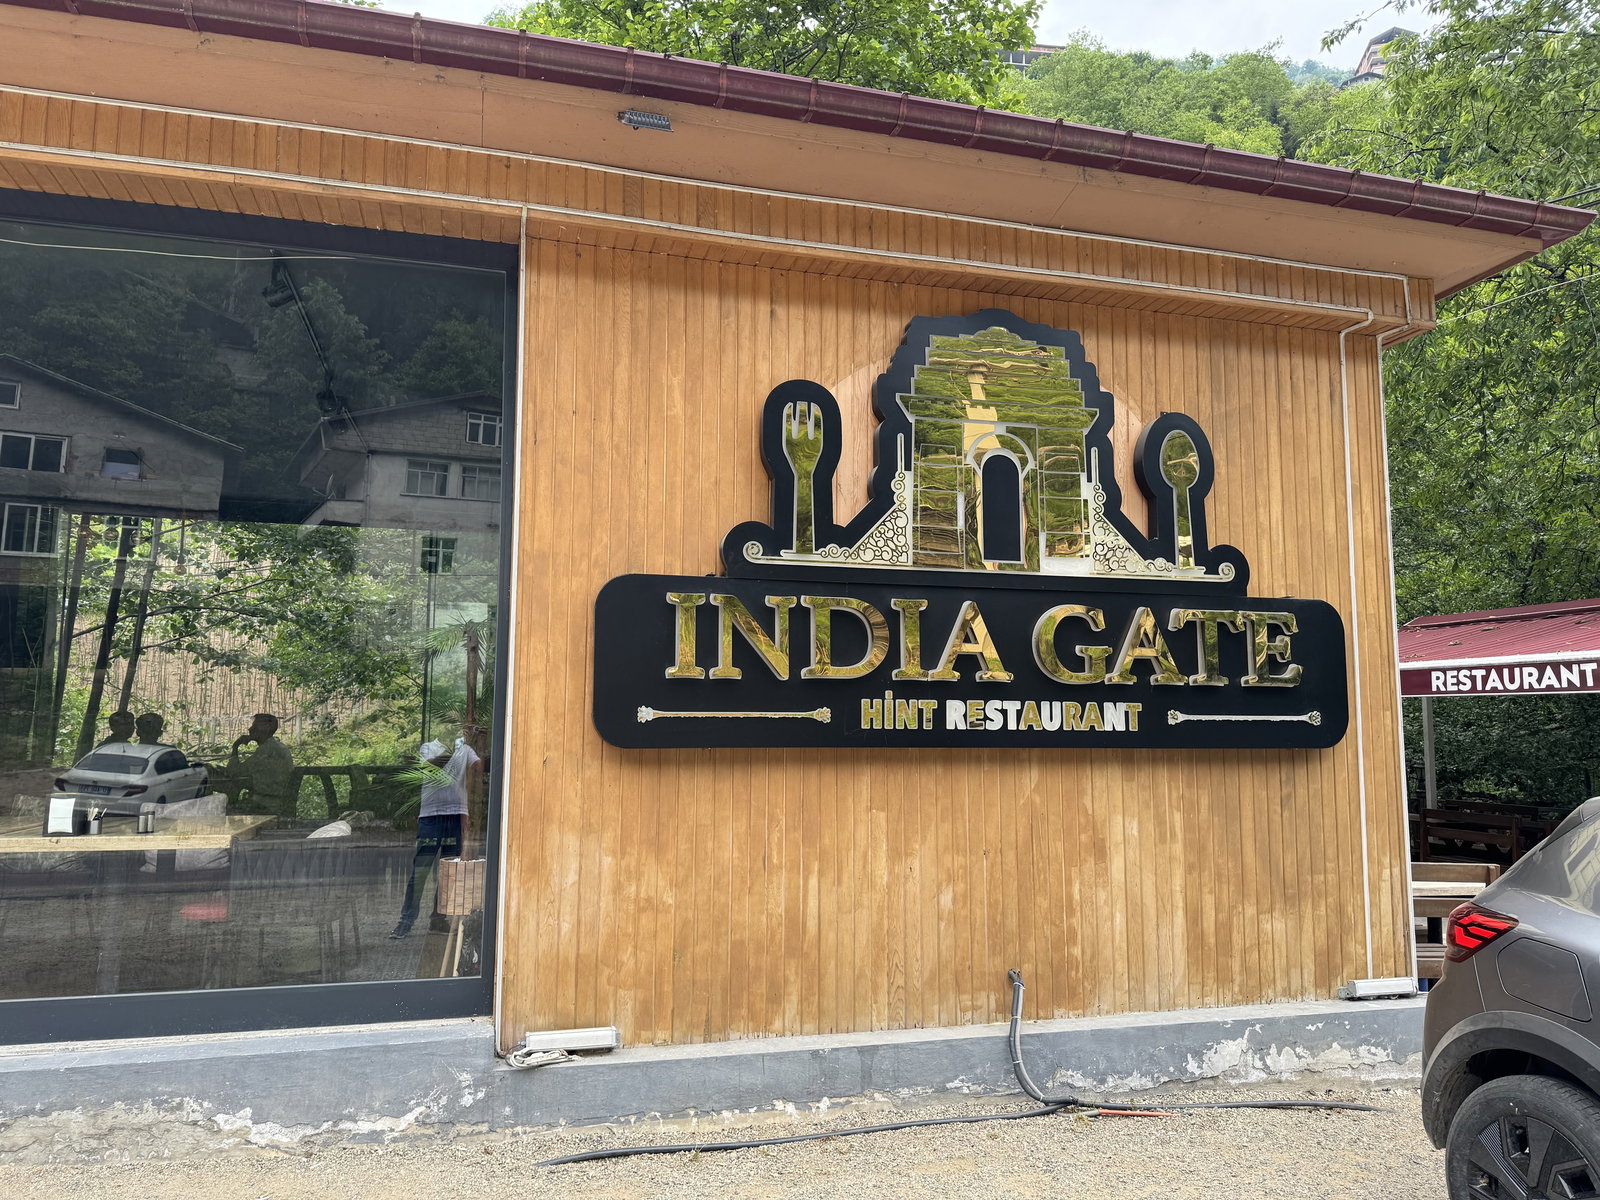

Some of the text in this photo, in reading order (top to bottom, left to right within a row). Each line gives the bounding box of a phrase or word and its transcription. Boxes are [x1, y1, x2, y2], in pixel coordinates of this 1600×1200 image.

[664, 592, 1303, 687] INDIA GATE
[1431, 663, 1598, 692] RESTAURANT
[945, 700, 1142, 732] RESTAURANT
